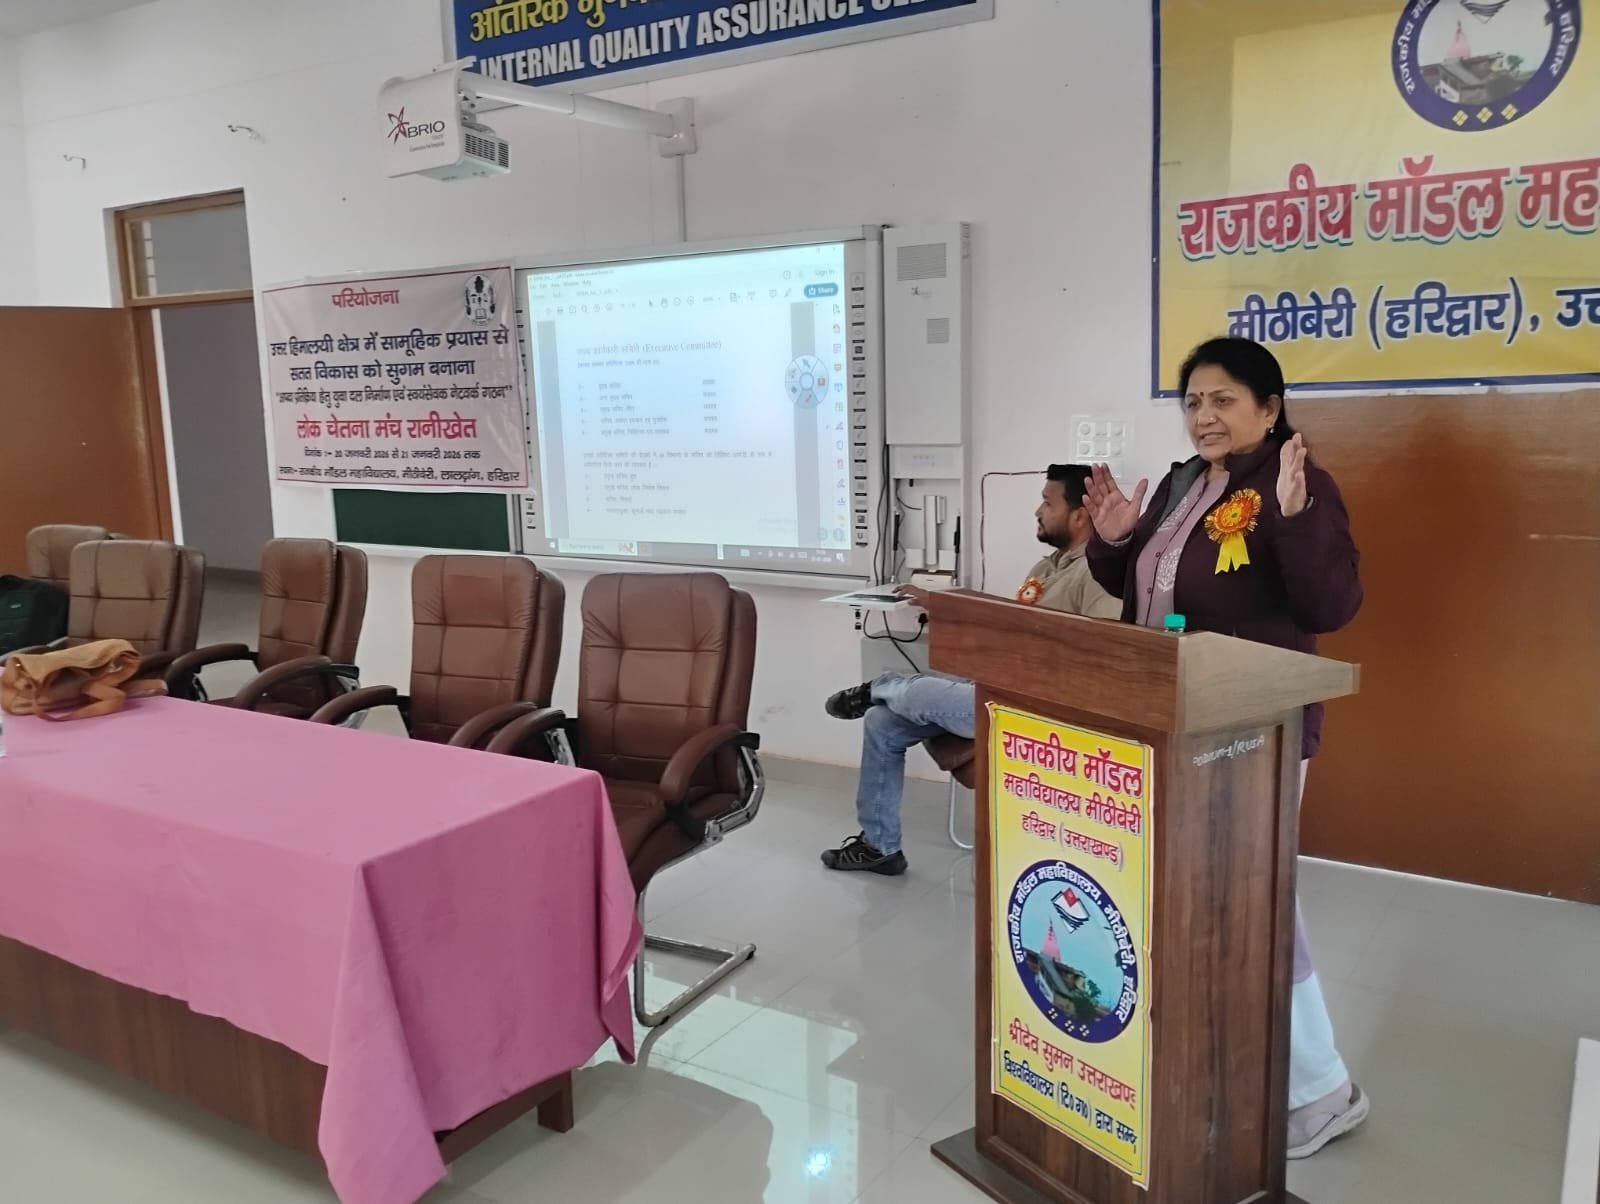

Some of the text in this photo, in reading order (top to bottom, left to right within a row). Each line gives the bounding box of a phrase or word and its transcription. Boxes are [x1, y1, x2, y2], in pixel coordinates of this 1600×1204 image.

[479, 38, 585, 83] INTERNAL
[589, 15, 691, 69] QUALITY
[1179, 162, 1357, 258] राजकीय
[1367, 155, 1511, 242] मॉडल
[332, 286, 401, 308] परियोजना
[1227, 286, 1357, 342] मीठीबेरी
[289, 334, 333, 356] हिमालयी
[337, 333, 360, 352] क्षेत्र
[363, 331, 379, 351] में
[380, 328, 441, 356] सामूहिक
[446, 329, 488, 350] प्रयास
[492, 324, 509, 345] से
[290, 360, 476, 385] सतत विकास को सुगम बनाना
[296, 410, 477, 440] लोक चेतना मंच रानीखेत
[324, 466, 347, 478] मॉडल
[487, 468, 520, 482] हरिद्वार
[392, 447, 400, 459] से
[411, 447, 440, 459] जनवरी
[464, 450, 480, 459] तक
[1002, 731, 1142, 797] राजकीय मॉडल
[1003, 772, 1082, 814] महाविद्यालय
[1022, 811, 1124, 872] हरिद्वार (उत्तराखण्ड)
[1015, 872, 1039, 903] मॉडल
[1008, 903, 1025, 965] राजकीय
[1009, 1017, 1039, 1055] श्रीदेव
[1041, 1040, 1074, 1074] सुमन
[1003, 1050, 1054, 1098] विश्वविद्यालय
[1095, 1108, 1113, 1134] द्वारा
